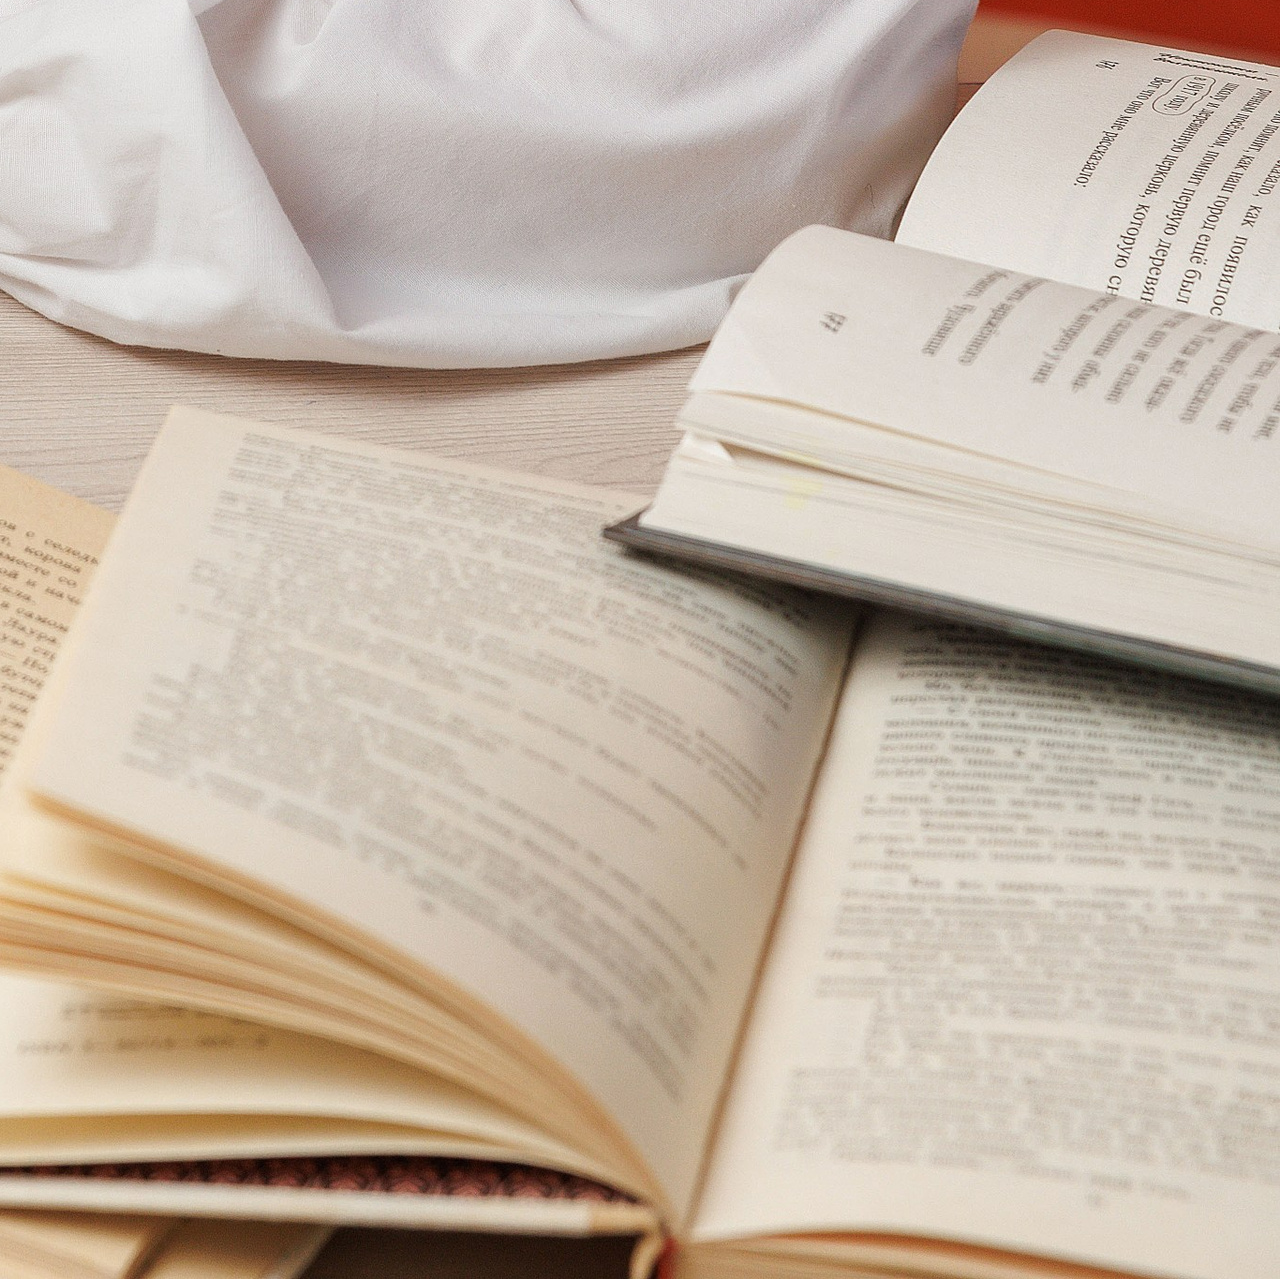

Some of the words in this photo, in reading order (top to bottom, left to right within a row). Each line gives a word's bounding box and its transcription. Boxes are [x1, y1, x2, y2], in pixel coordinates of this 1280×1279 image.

[1136, 89, 1156, 101] что
[1147, 76, 1172, 89] Вот
[1181, 81, 1206, 96] 1917
[1210, 82, 1240, 102] школу
[1124, 100, 1144, 114] оно
[1163, 95, 1188, 111] году.
[1206, 101, 1220, 109] и
[1110, 114, 1132, 131] мне
[1170, 108, 1214, 153] деревянную
[1207, 113, 1250, 148] посёлком,
[1243, 123, 1280, 153] помнит,
[1073, 130, 1118, 188] рассказало:
[1188, 150, 1220, 187] помнит
[1234, 154, 1255, 171] как
[1138, 154, 1179, 198] церковь,
[1221, 171, 1244, 193] наш
[1253, 157, 1280, 197] казало,
[1163, 187, 1196, 236] первую
[1201, 195, 1230, 231] город
[1241, 204, 1262, 228] как
[1114, 203, 1150, 269] которую
[1189, 233, 1212, 266] ещё
[1176, 269, 1202, 305] был
[23, 546, 81, 573] корова
